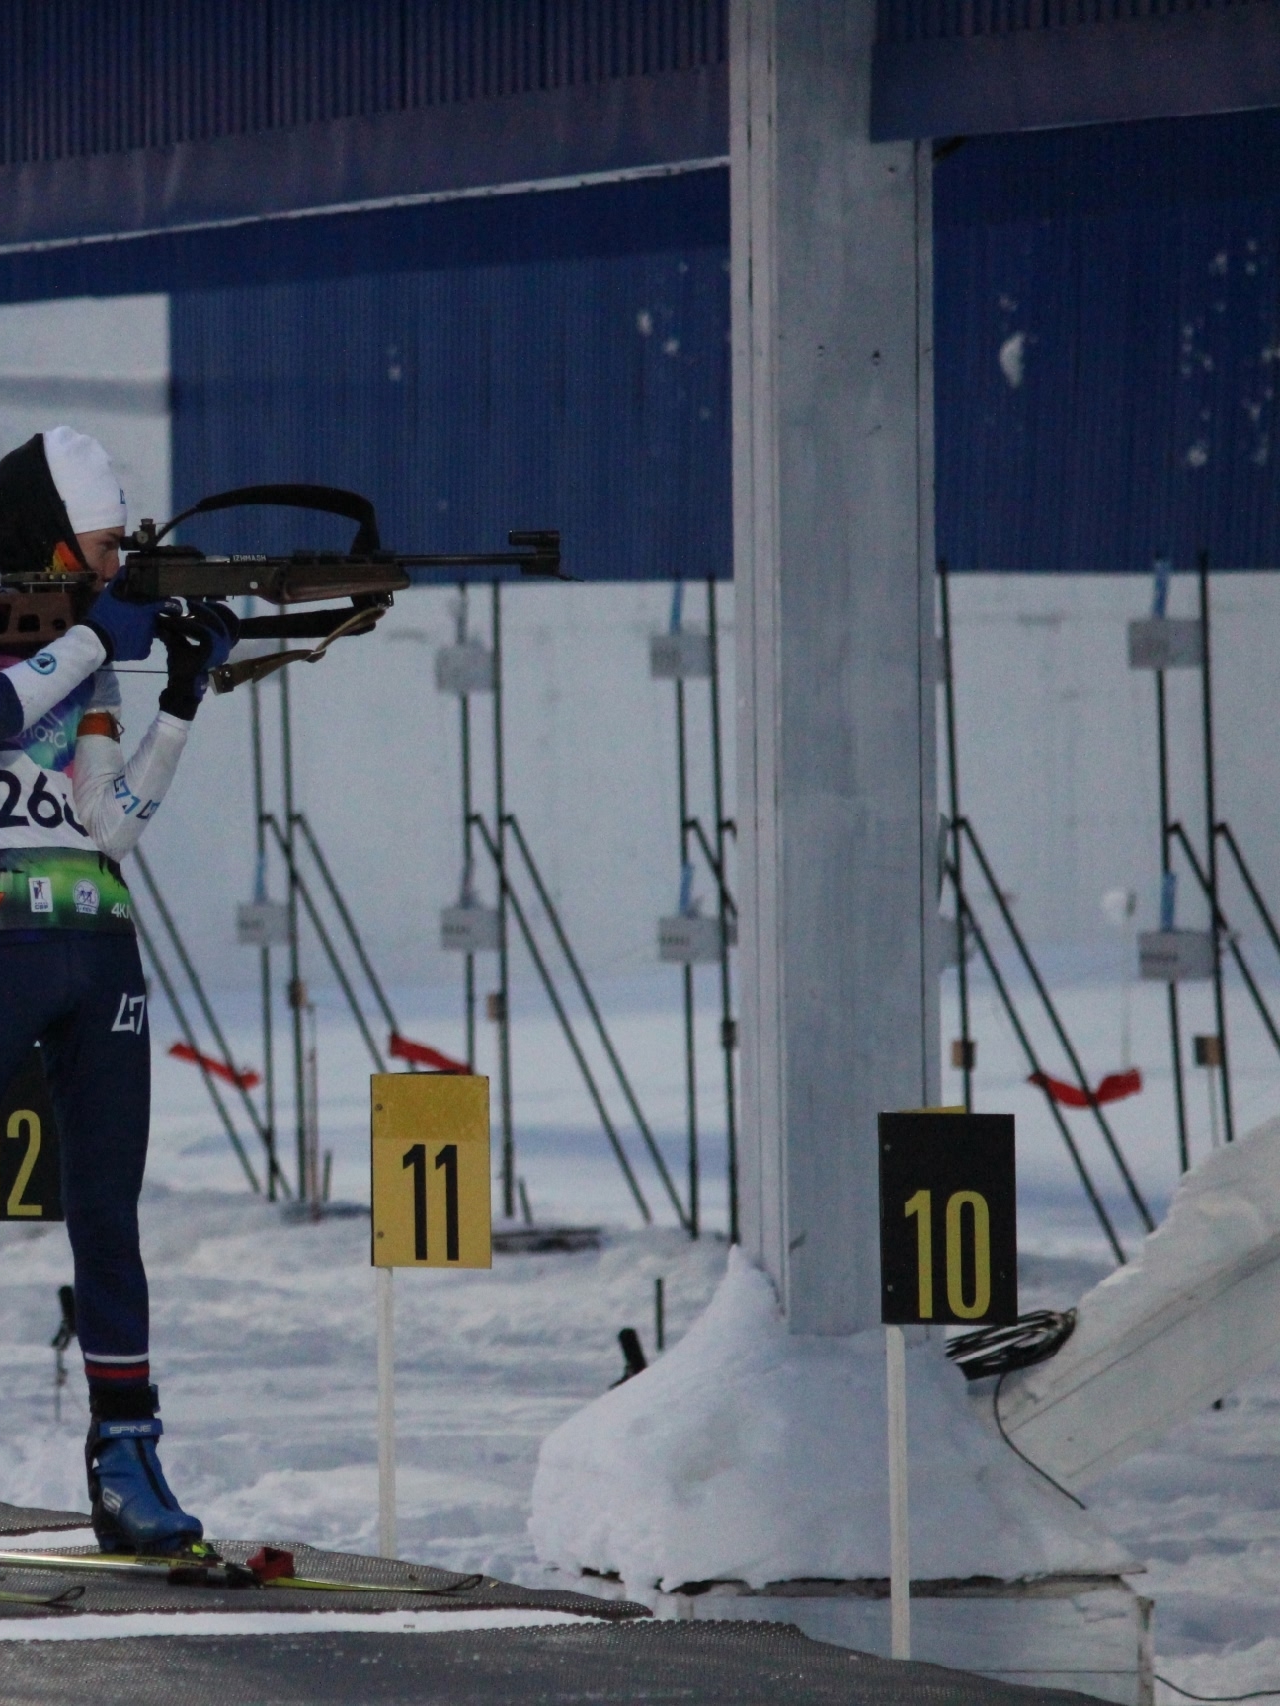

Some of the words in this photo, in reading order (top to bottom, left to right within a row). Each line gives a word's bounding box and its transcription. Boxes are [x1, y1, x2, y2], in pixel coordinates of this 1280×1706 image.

[402, 1143, 460, 1261] 11
[904, 1189, 992, 1319] 10
[109, 1423, 152, 1435] SPINE
